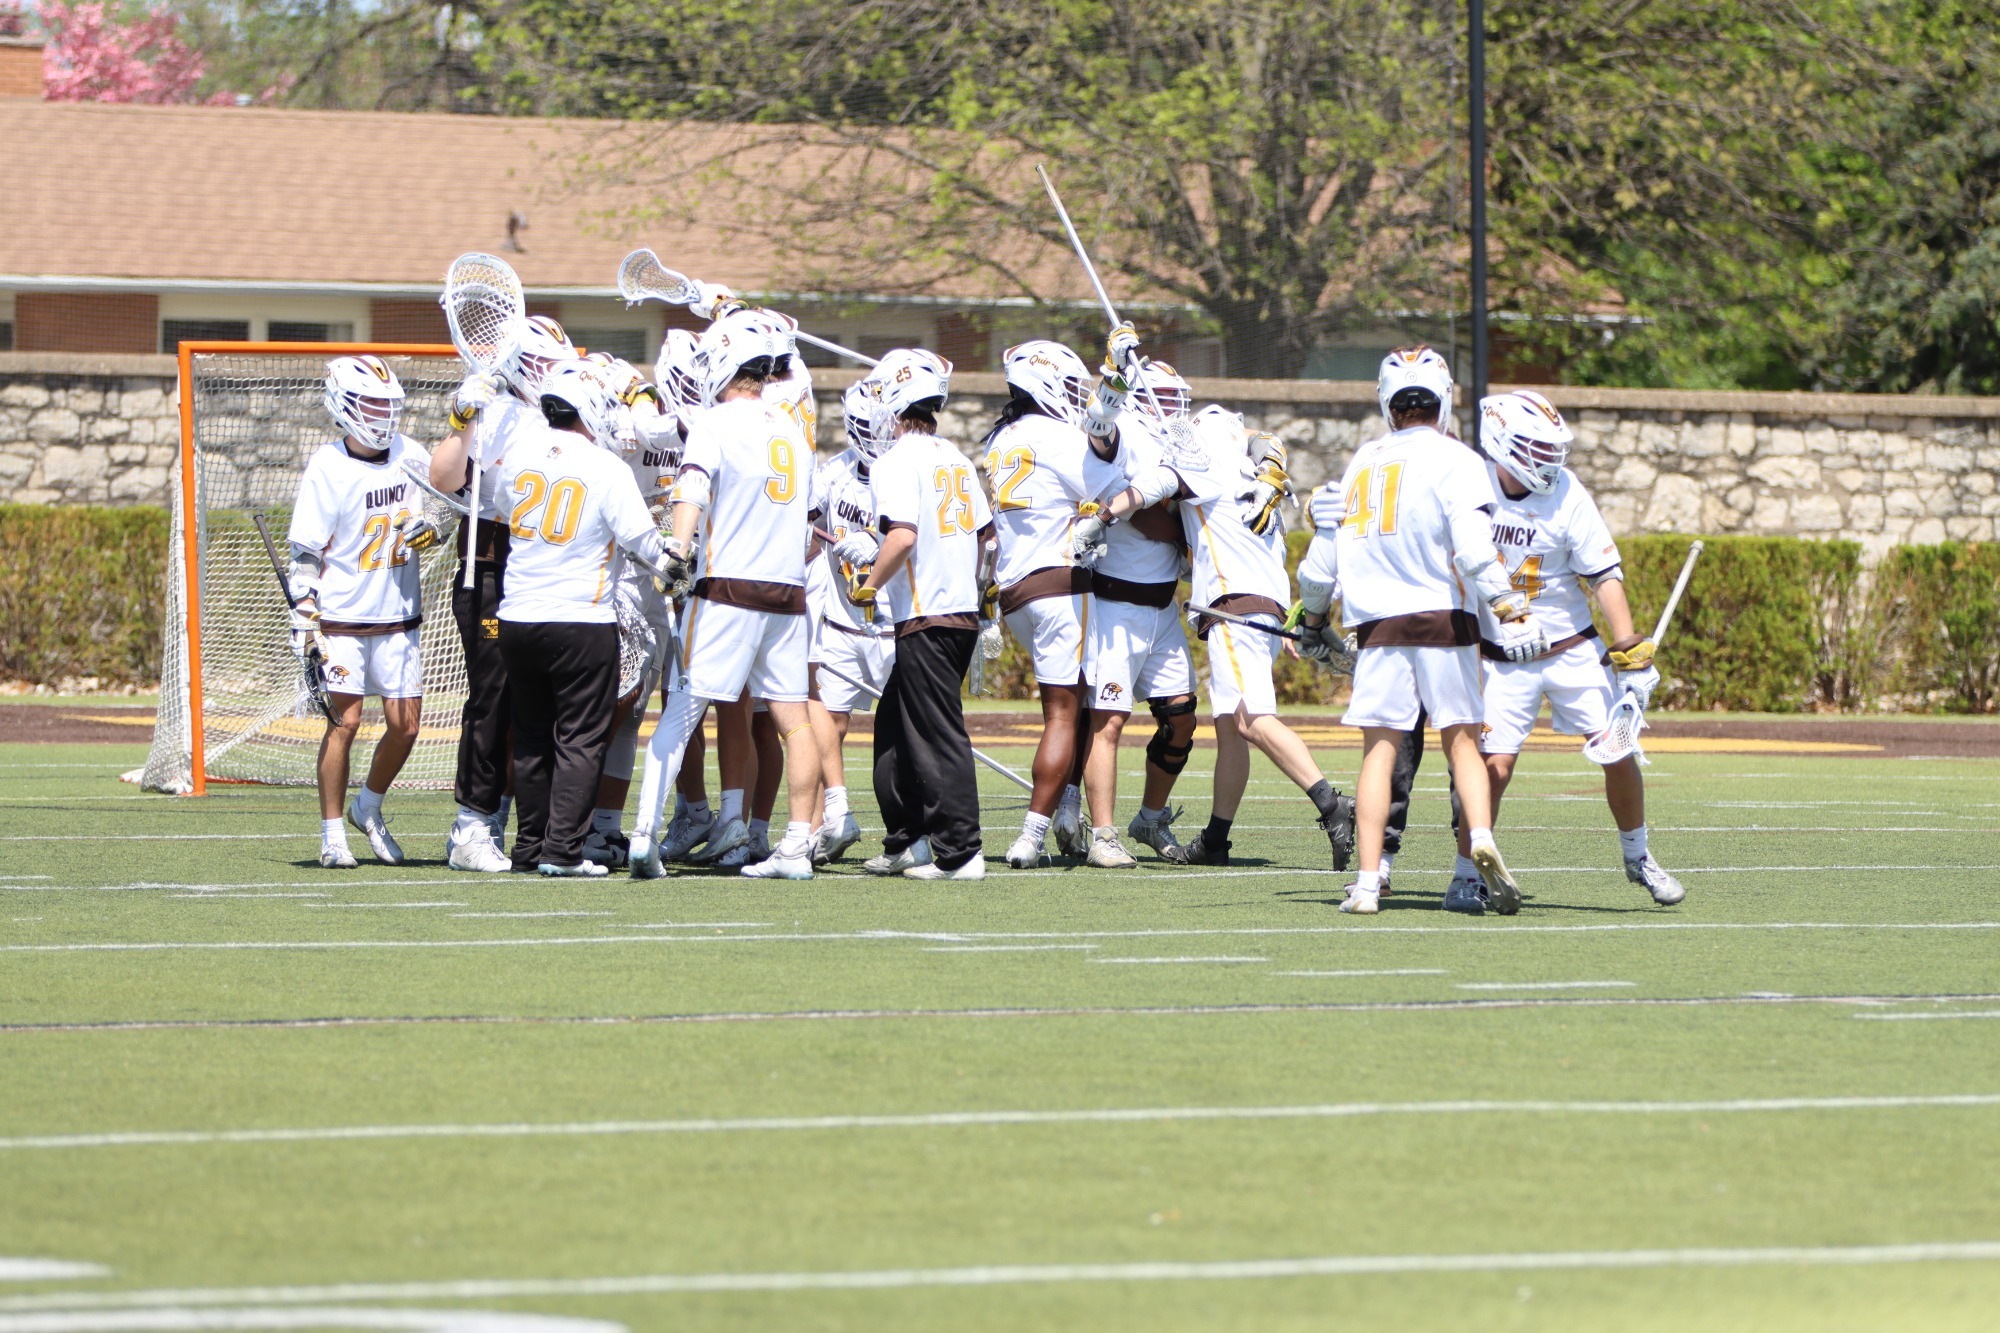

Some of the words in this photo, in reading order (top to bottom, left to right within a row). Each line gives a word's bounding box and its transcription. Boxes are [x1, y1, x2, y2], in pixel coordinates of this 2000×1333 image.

[895, 365, 912, 384] 25
[642, 449, 684, 468] QUINC
[763, 435, 797, 505] 9
[365, 483, 408, 509] QUINCY
[509, 469, 589, 547] 20
[933, 464, 975, 538] 25
[1340, 460, 1406, 540] 41
[358, 507, 409, 573] 22
[1493, 523, 1537, 547] UINCY
[1497, 550, 1547, 601] 4
